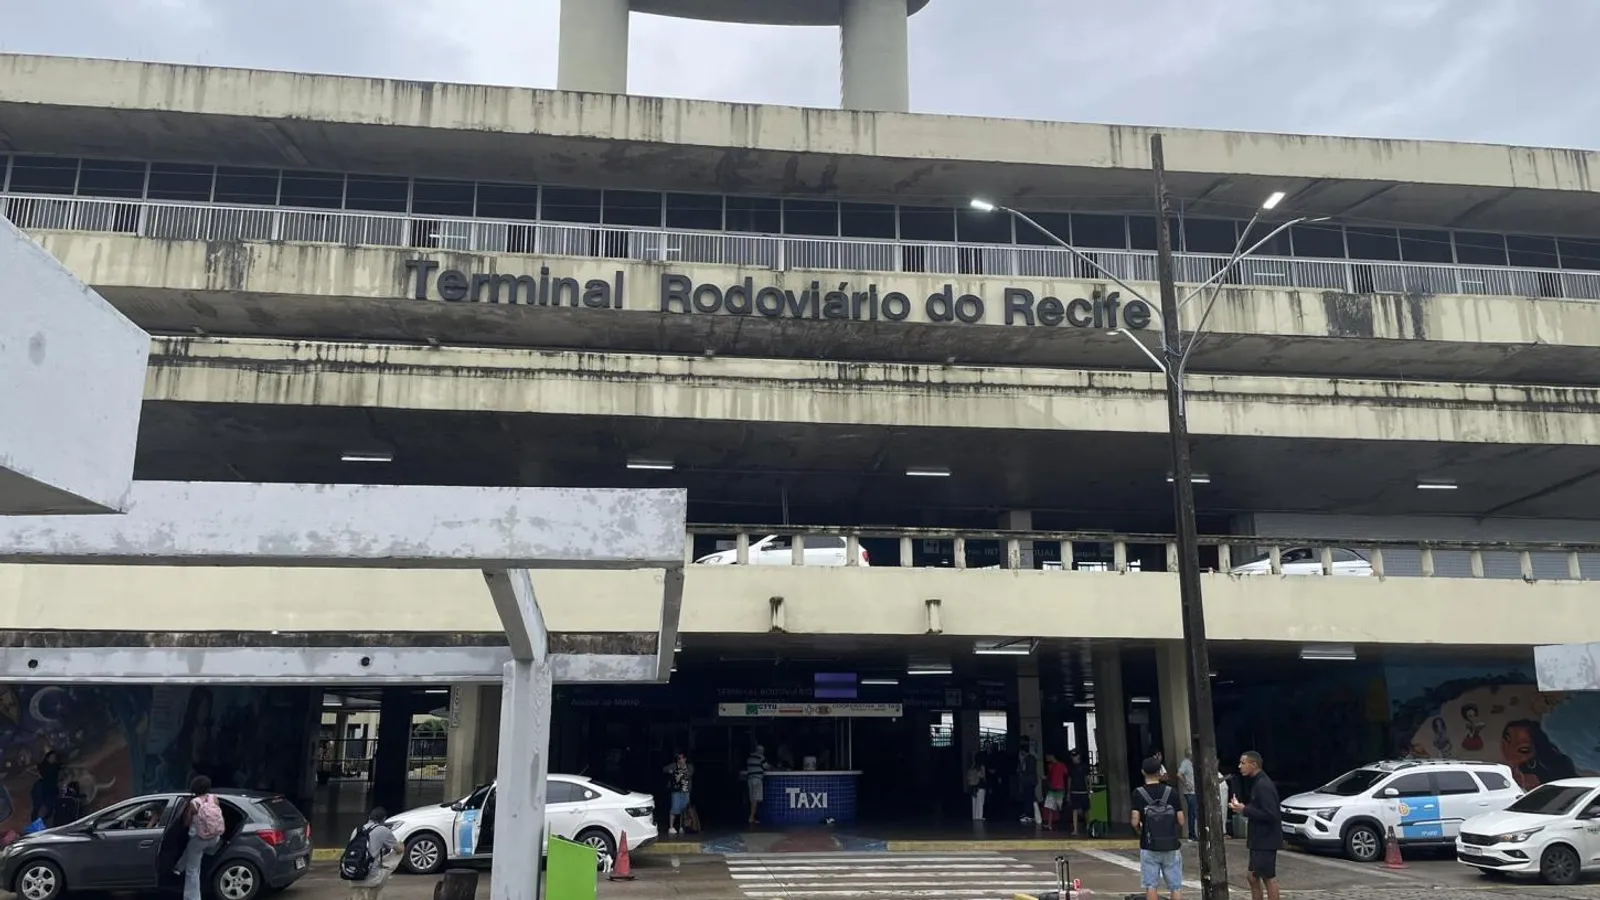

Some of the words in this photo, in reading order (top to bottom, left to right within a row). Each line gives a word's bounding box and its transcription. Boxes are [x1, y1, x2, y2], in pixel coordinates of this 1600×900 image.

[405, 259, 625, 309] Terminal
[661, 273, 911, 322] Rodoviário
[926, 284, 985, 323] do
[1004, 287, 1151, 329] Recife
